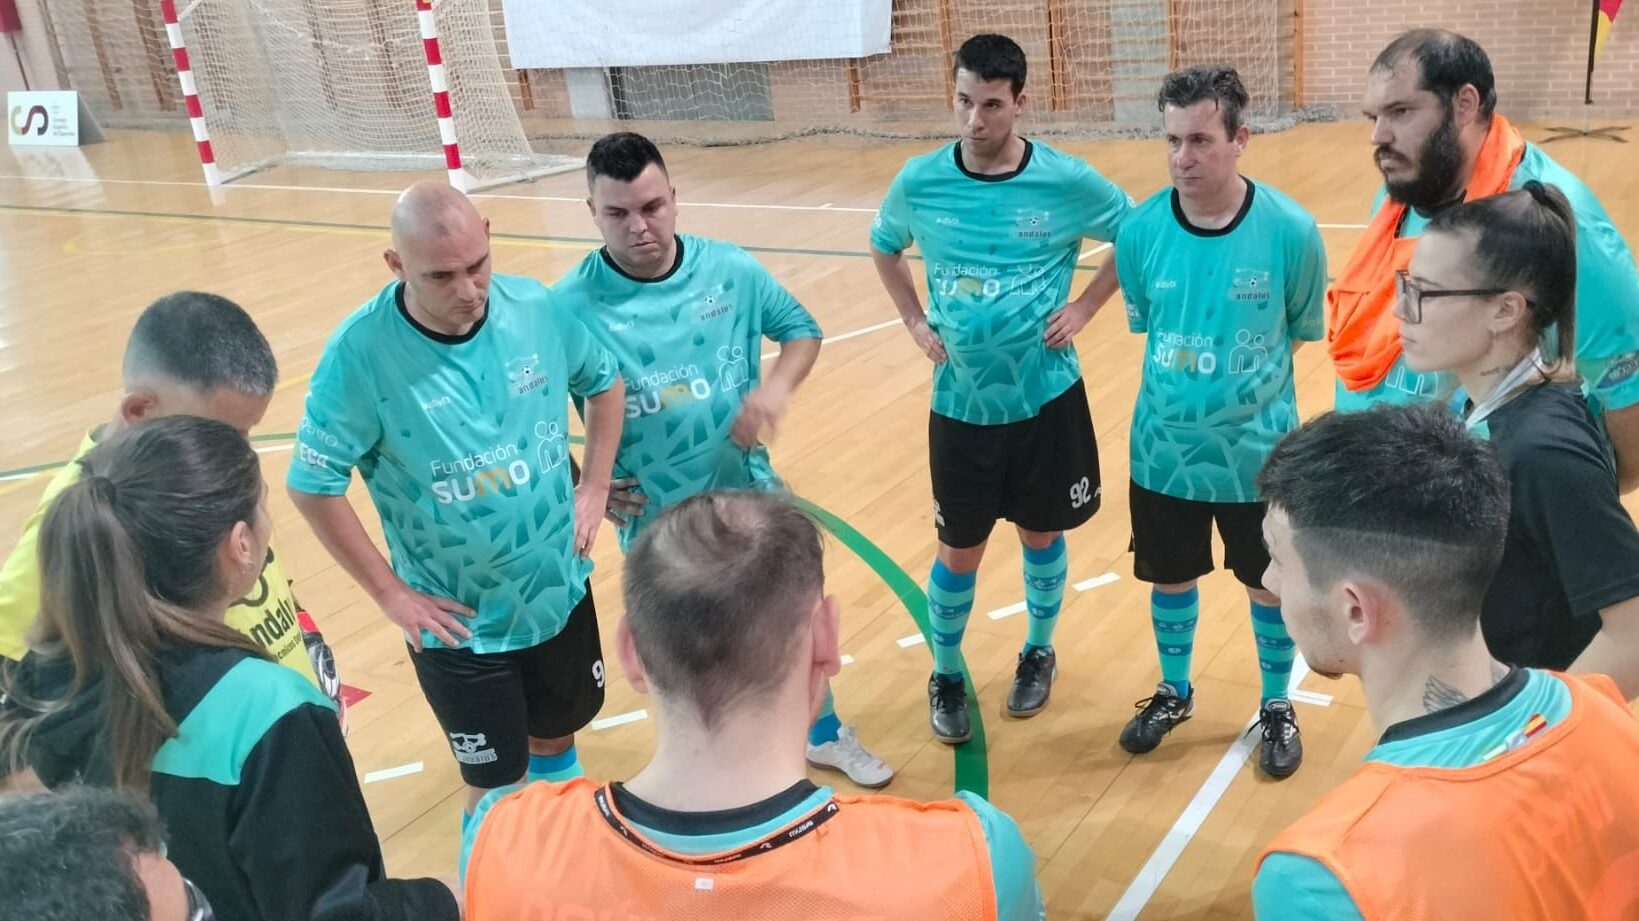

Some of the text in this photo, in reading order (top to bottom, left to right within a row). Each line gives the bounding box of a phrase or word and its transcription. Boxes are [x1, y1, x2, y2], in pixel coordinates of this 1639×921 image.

[624, 364, 699, 391] Fundación
[625, 378, 711, 418] sumo
[430, 443, 518, 477] Fundación
[431, 459, 530, 504] sumo
[1069, 476, 1092, 508] 92
